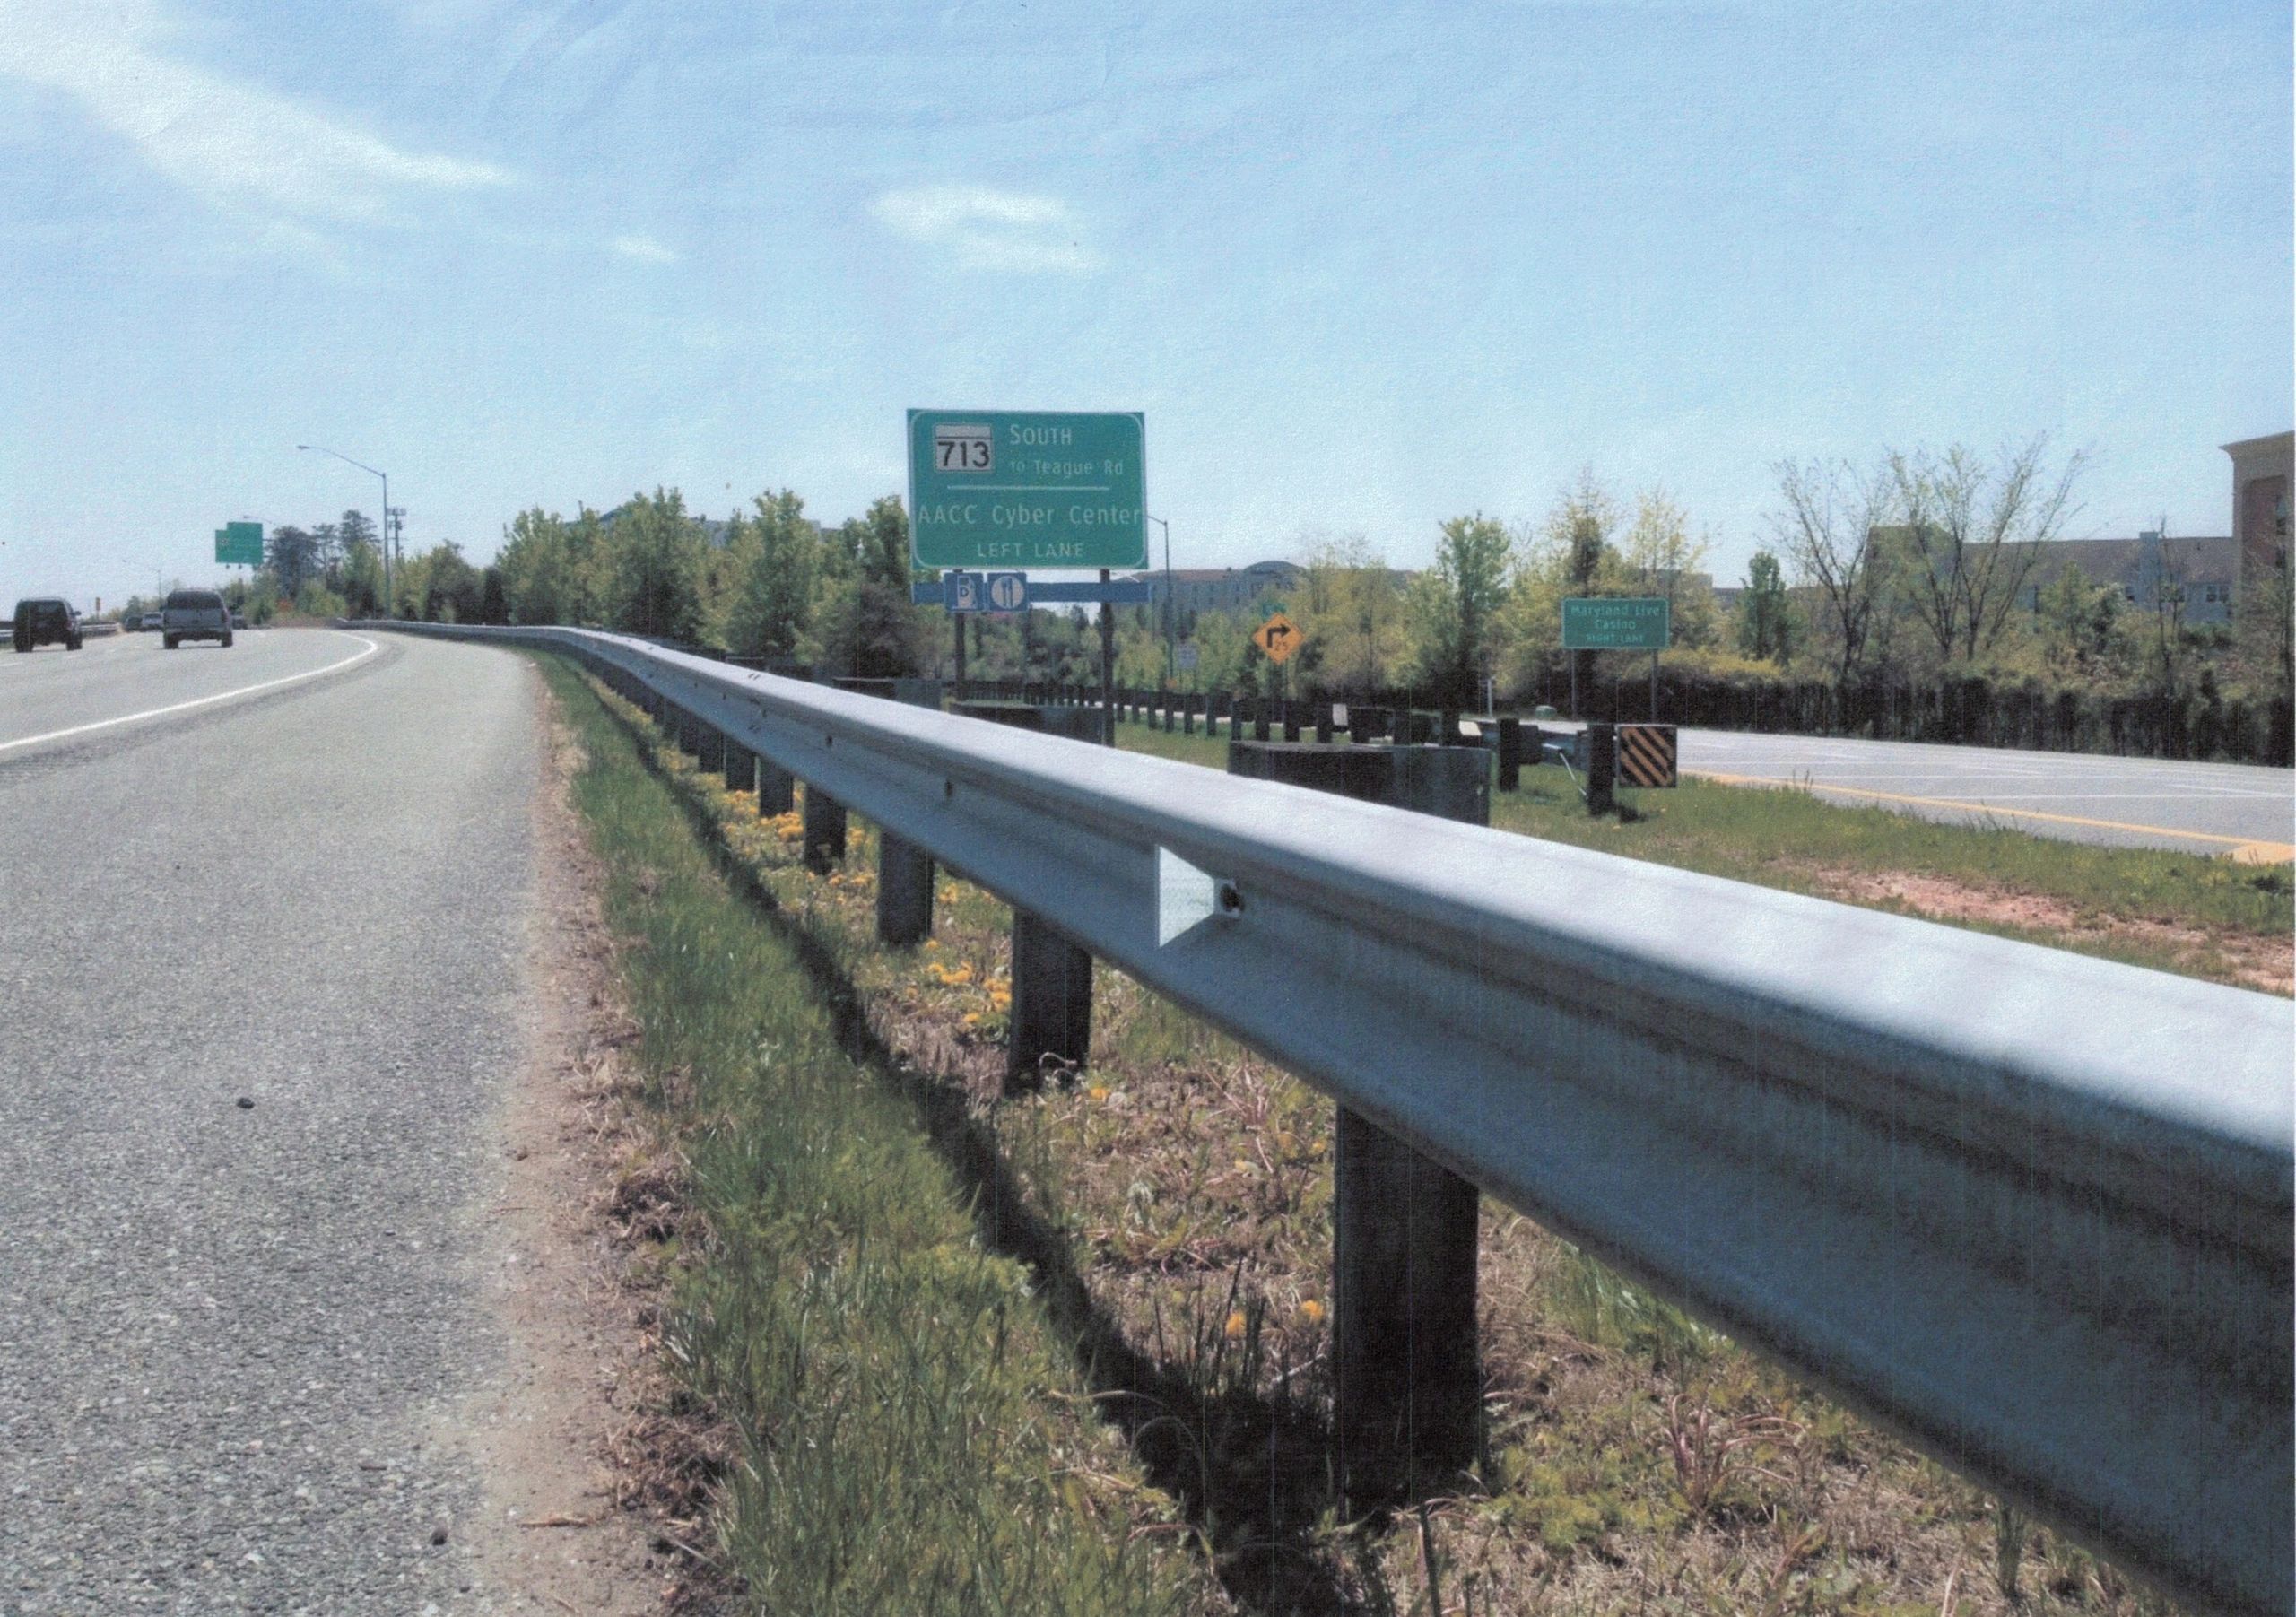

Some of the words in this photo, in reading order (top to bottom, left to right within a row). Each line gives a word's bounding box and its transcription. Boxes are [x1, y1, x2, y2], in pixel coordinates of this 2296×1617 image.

[937, 440, 990, 468] 713
[1033, 459, 1093, 480] Teague
[1104, 458, 1123, 474] Rd
[918, 504, 978, 525] AACC
[992, 504, 1055, 529] Cyber
[1069, 505, 1141, 525] Center
[977, 543, 1022, 559] LEFT
[1034, 543, 1084, 558] LANE
[1570, 604, 1629, 619] Maryland
[1595, 619, 1637, 630] Casino
